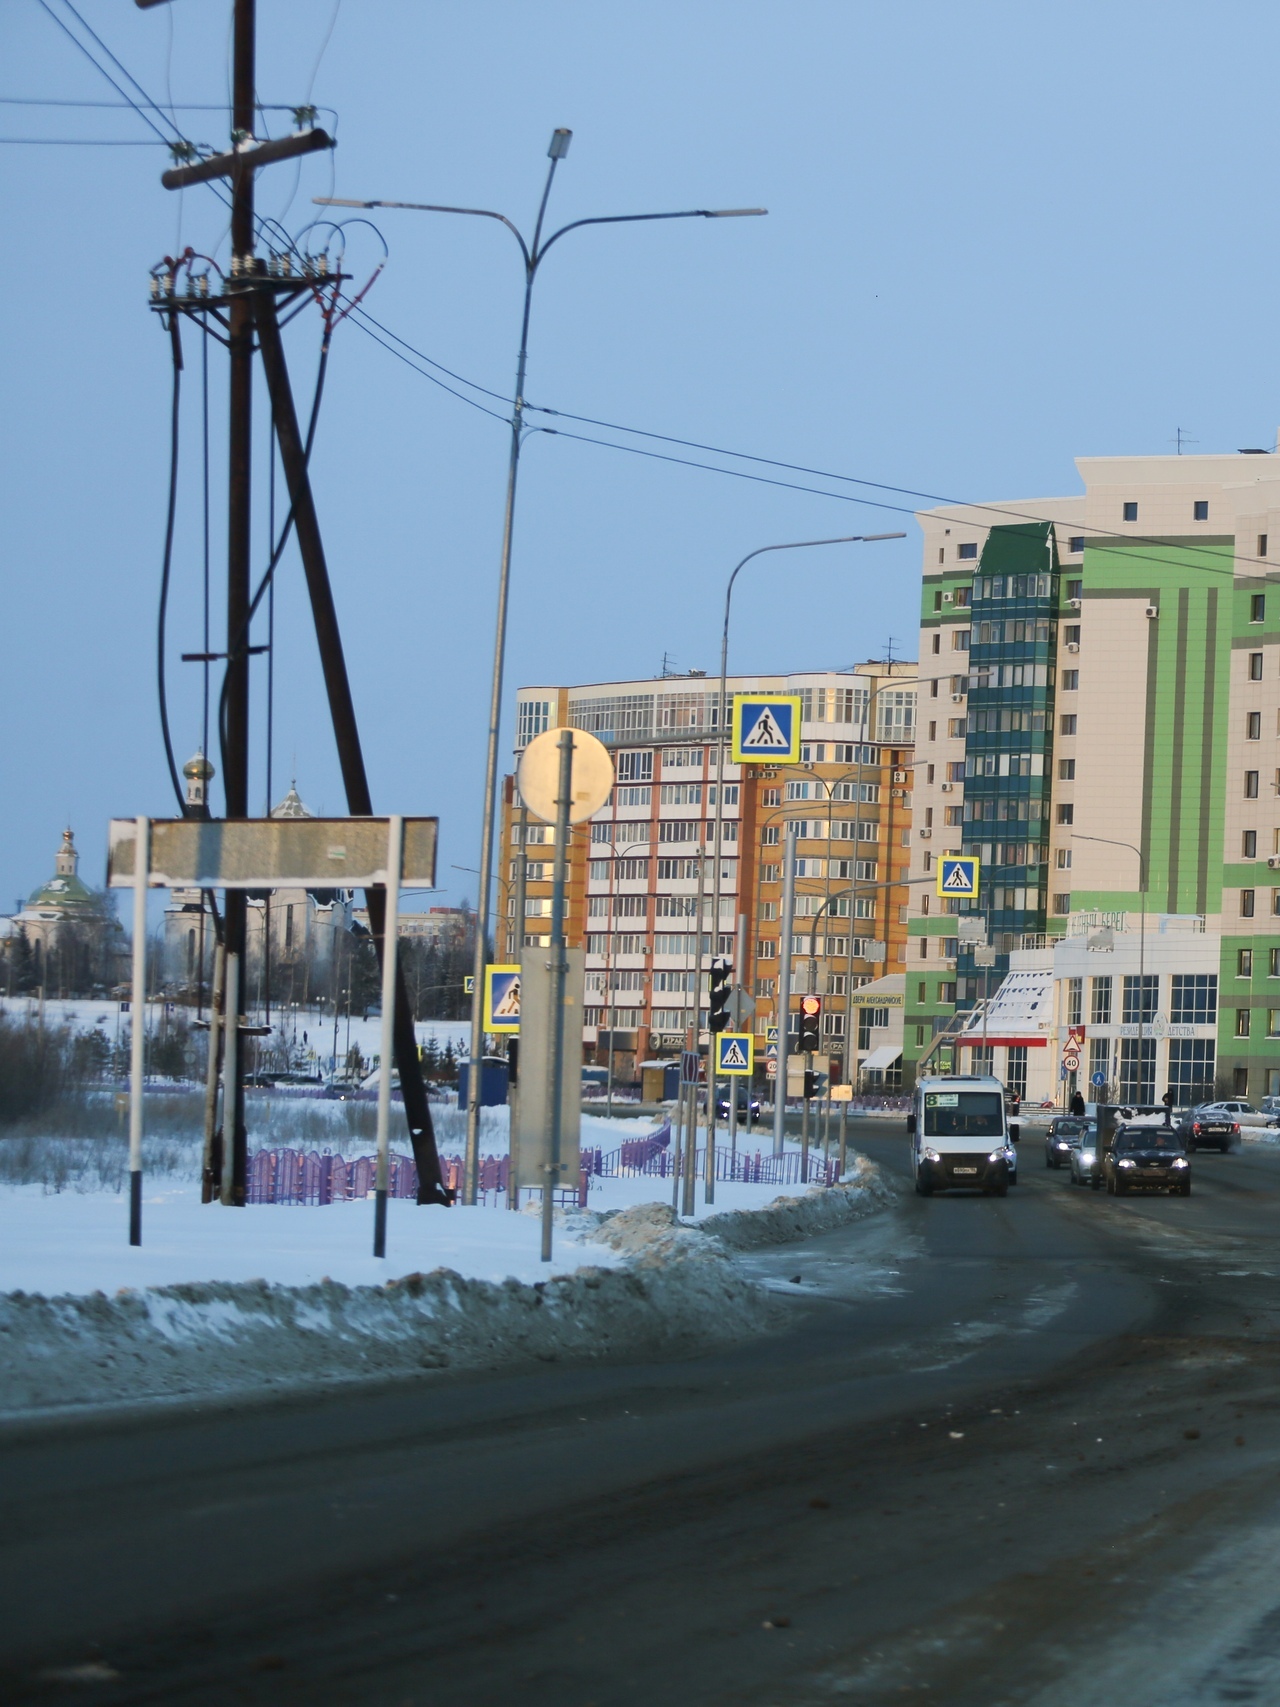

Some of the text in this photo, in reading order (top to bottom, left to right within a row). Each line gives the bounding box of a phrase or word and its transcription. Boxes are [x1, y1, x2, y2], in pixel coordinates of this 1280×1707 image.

[1120, 1027, 1195, 1036] РЕЗИДЕЦИЯ ДЕТСТВА
[926, 1095, 938, 1106] 8
